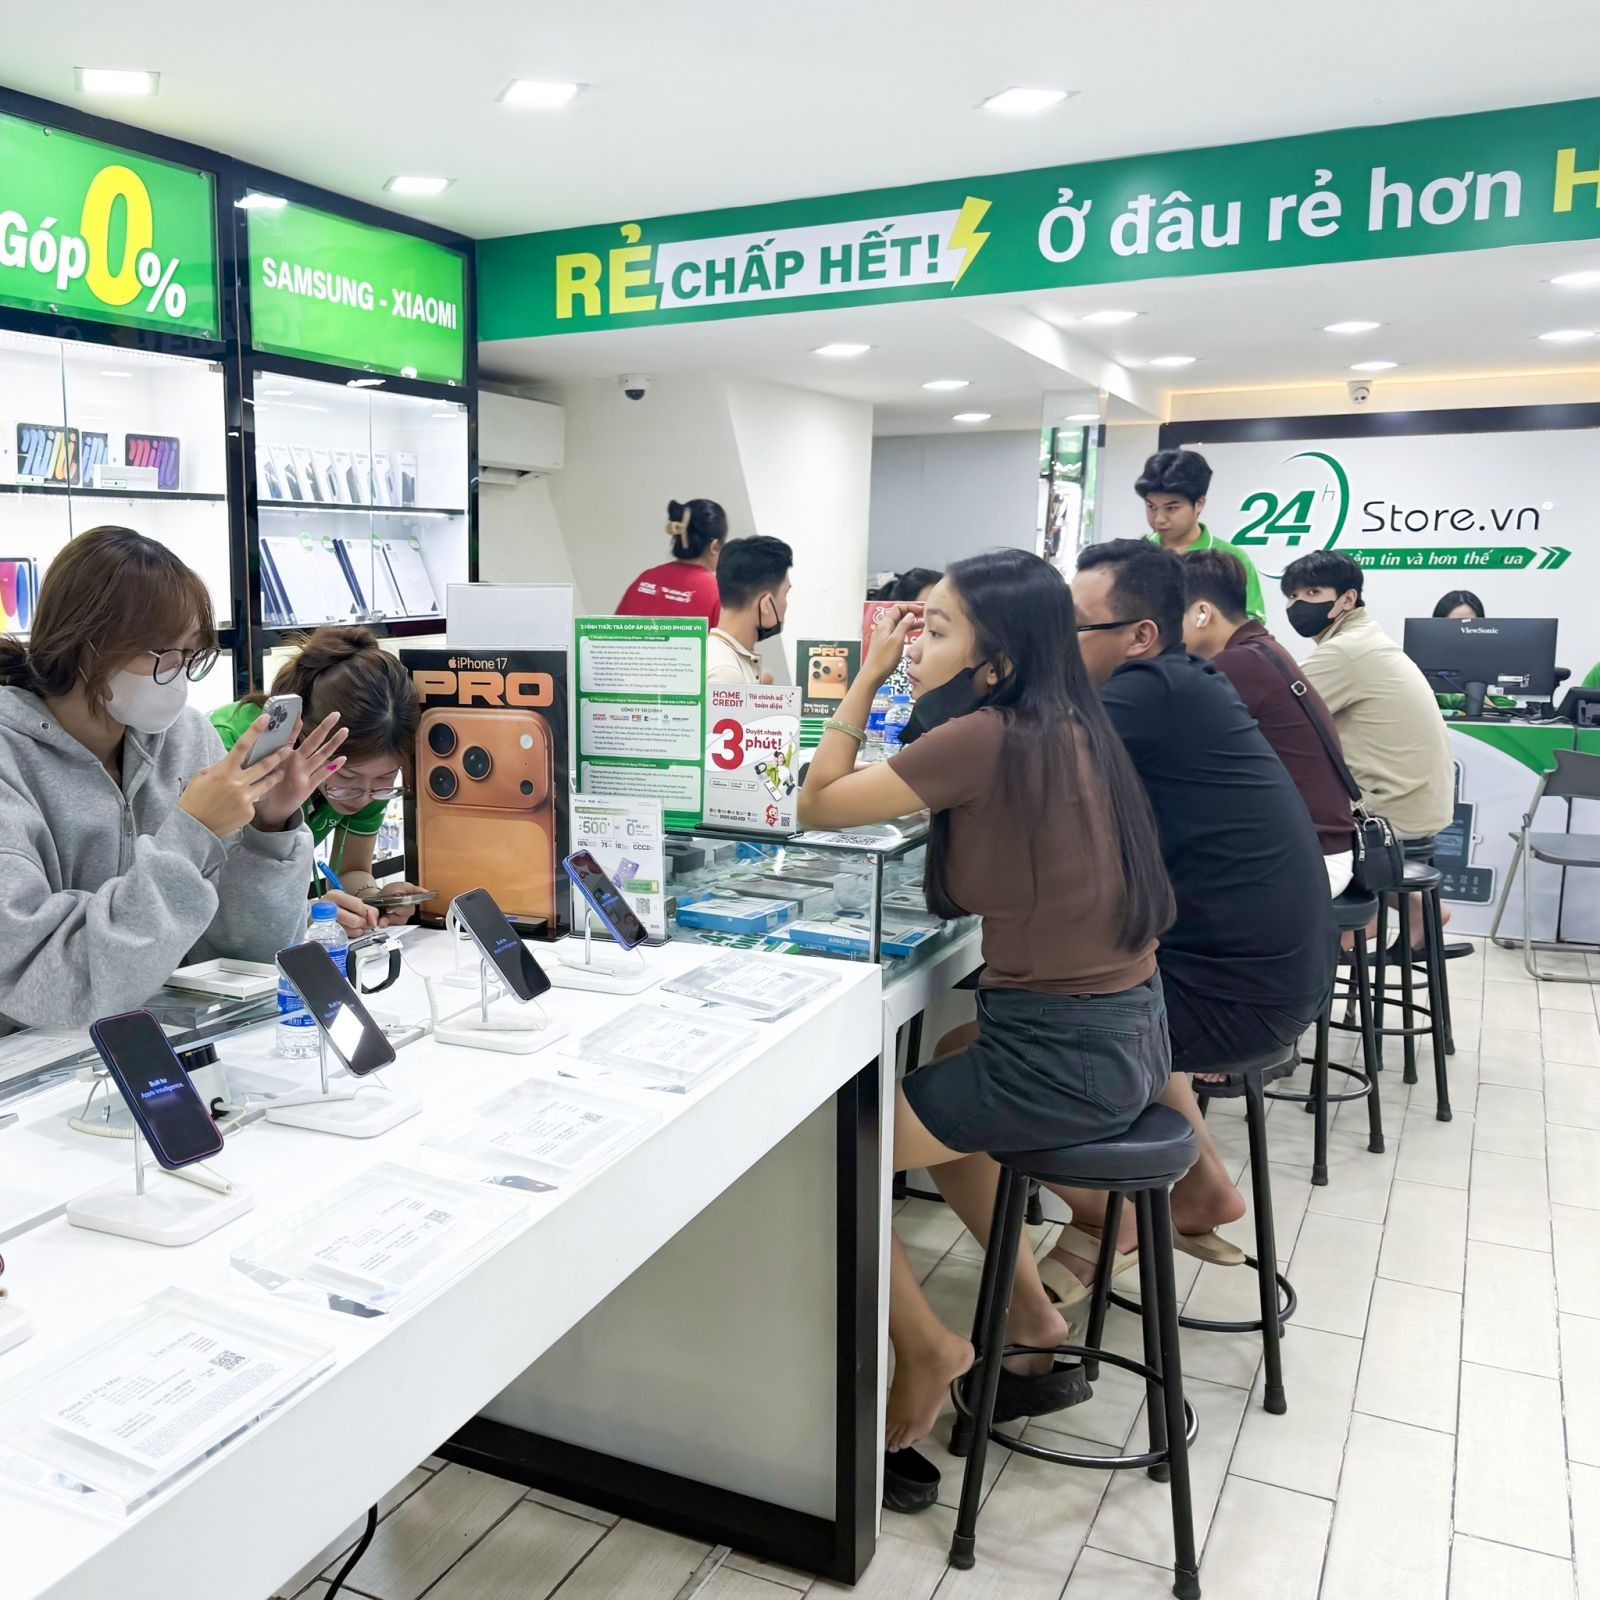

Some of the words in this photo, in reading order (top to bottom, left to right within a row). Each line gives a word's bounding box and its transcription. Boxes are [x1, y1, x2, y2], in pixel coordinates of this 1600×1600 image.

[1038, 187, 1092, 263] Ở
[1109, 190, 1241, 257] đâu
[1267, 169, 1342, 242] rẻ
[1368, 166, 1522, 232] hơn
[0, 210, 87, 291] Góp
[556, 223, 657, 319] RẺ
[671, 238, 805, 300] CHẤP
[819, 224, 941, 285] HẾT!
[262, 256, 374, 310] SAMSUNG
[391, 288, 457, 330] XIAOMI
[1361, 500, 1540, 533] Store.vn
[1380, 552, 1401, 566] tin
[1406, 552, 1424, 566] và
[1428, 551, 1457, 566] hơn
[1463, 549, 1494, 565] thế
[1460, 626, 1500, 635] ViewSonic
[457, 657, 495, 669] iPhone
[496, 658, 508, 669] 17
[412, 670, 554, 707] PRO
[713, 690, 740, 699] HOME
[713, 699, 744, 707] CREDIT
[712, 718, 744, 770] 3
[745, 736, 782, 751] phút!
[746, 728, 763, 736] Duyệt
